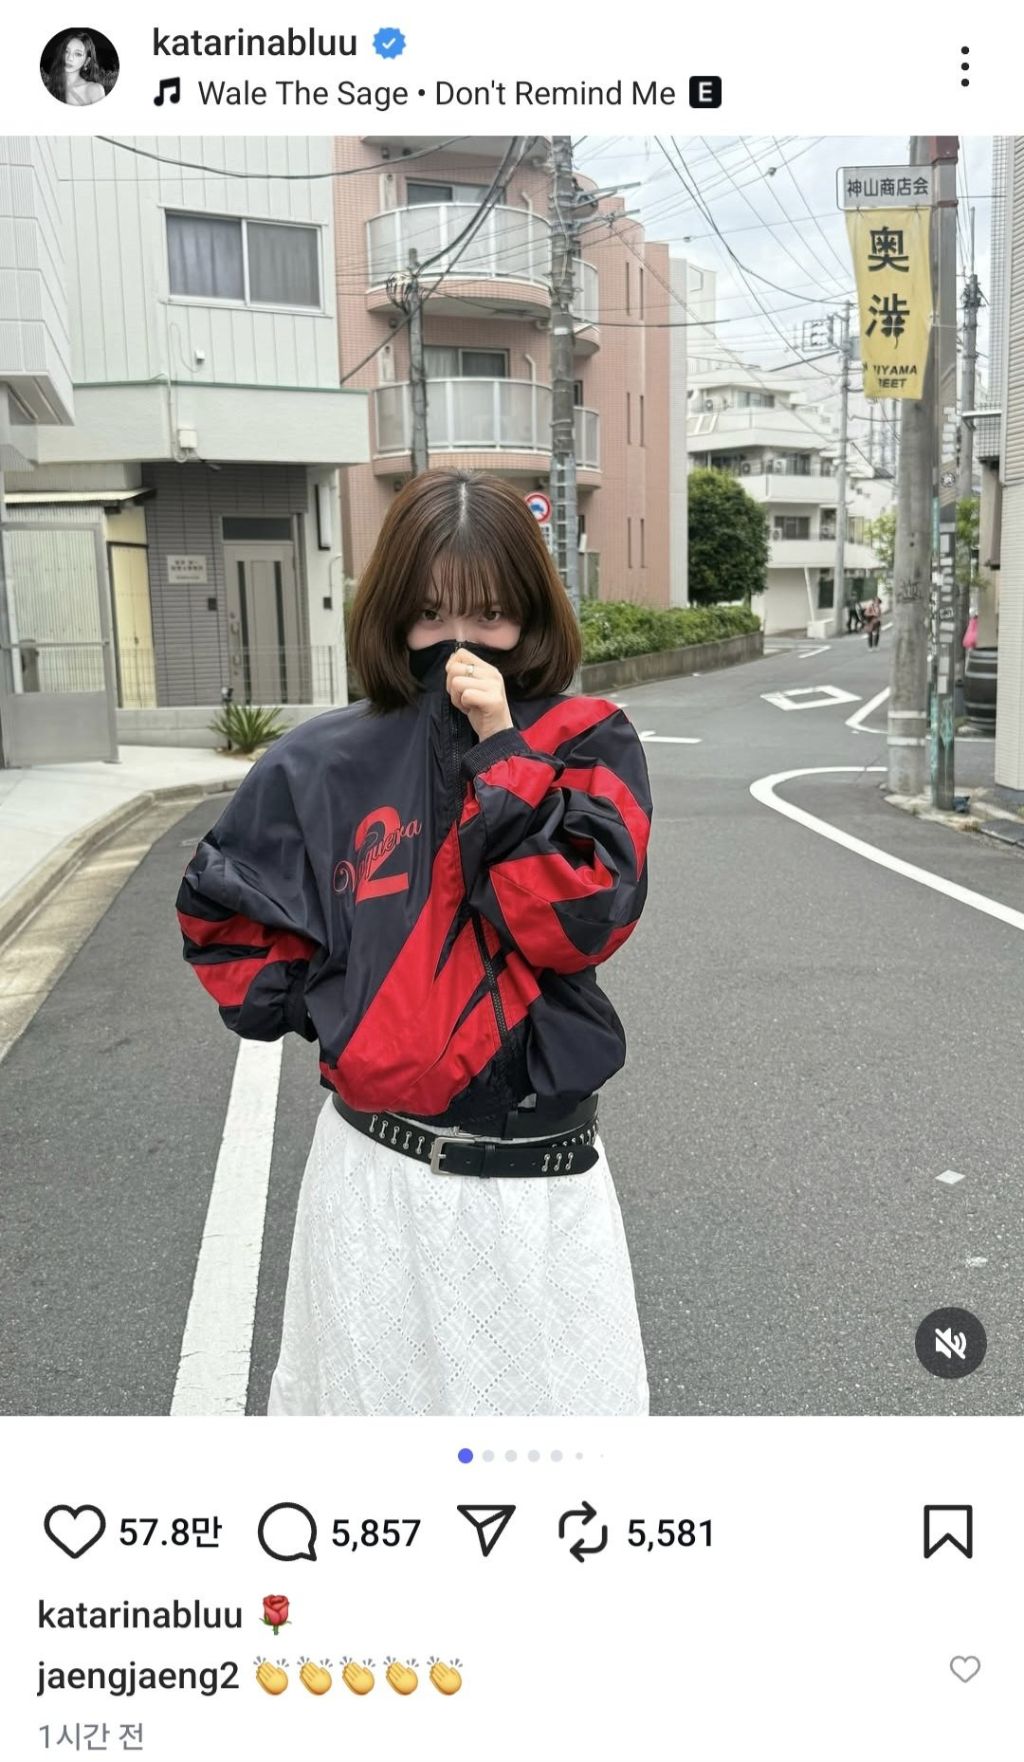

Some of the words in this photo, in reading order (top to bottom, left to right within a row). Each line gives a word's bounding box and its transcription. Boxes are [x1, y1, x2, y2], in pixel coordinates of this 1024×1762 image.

[847, 176, 929, 198] 神山商店会
[355, 805, 410, 904] 2
